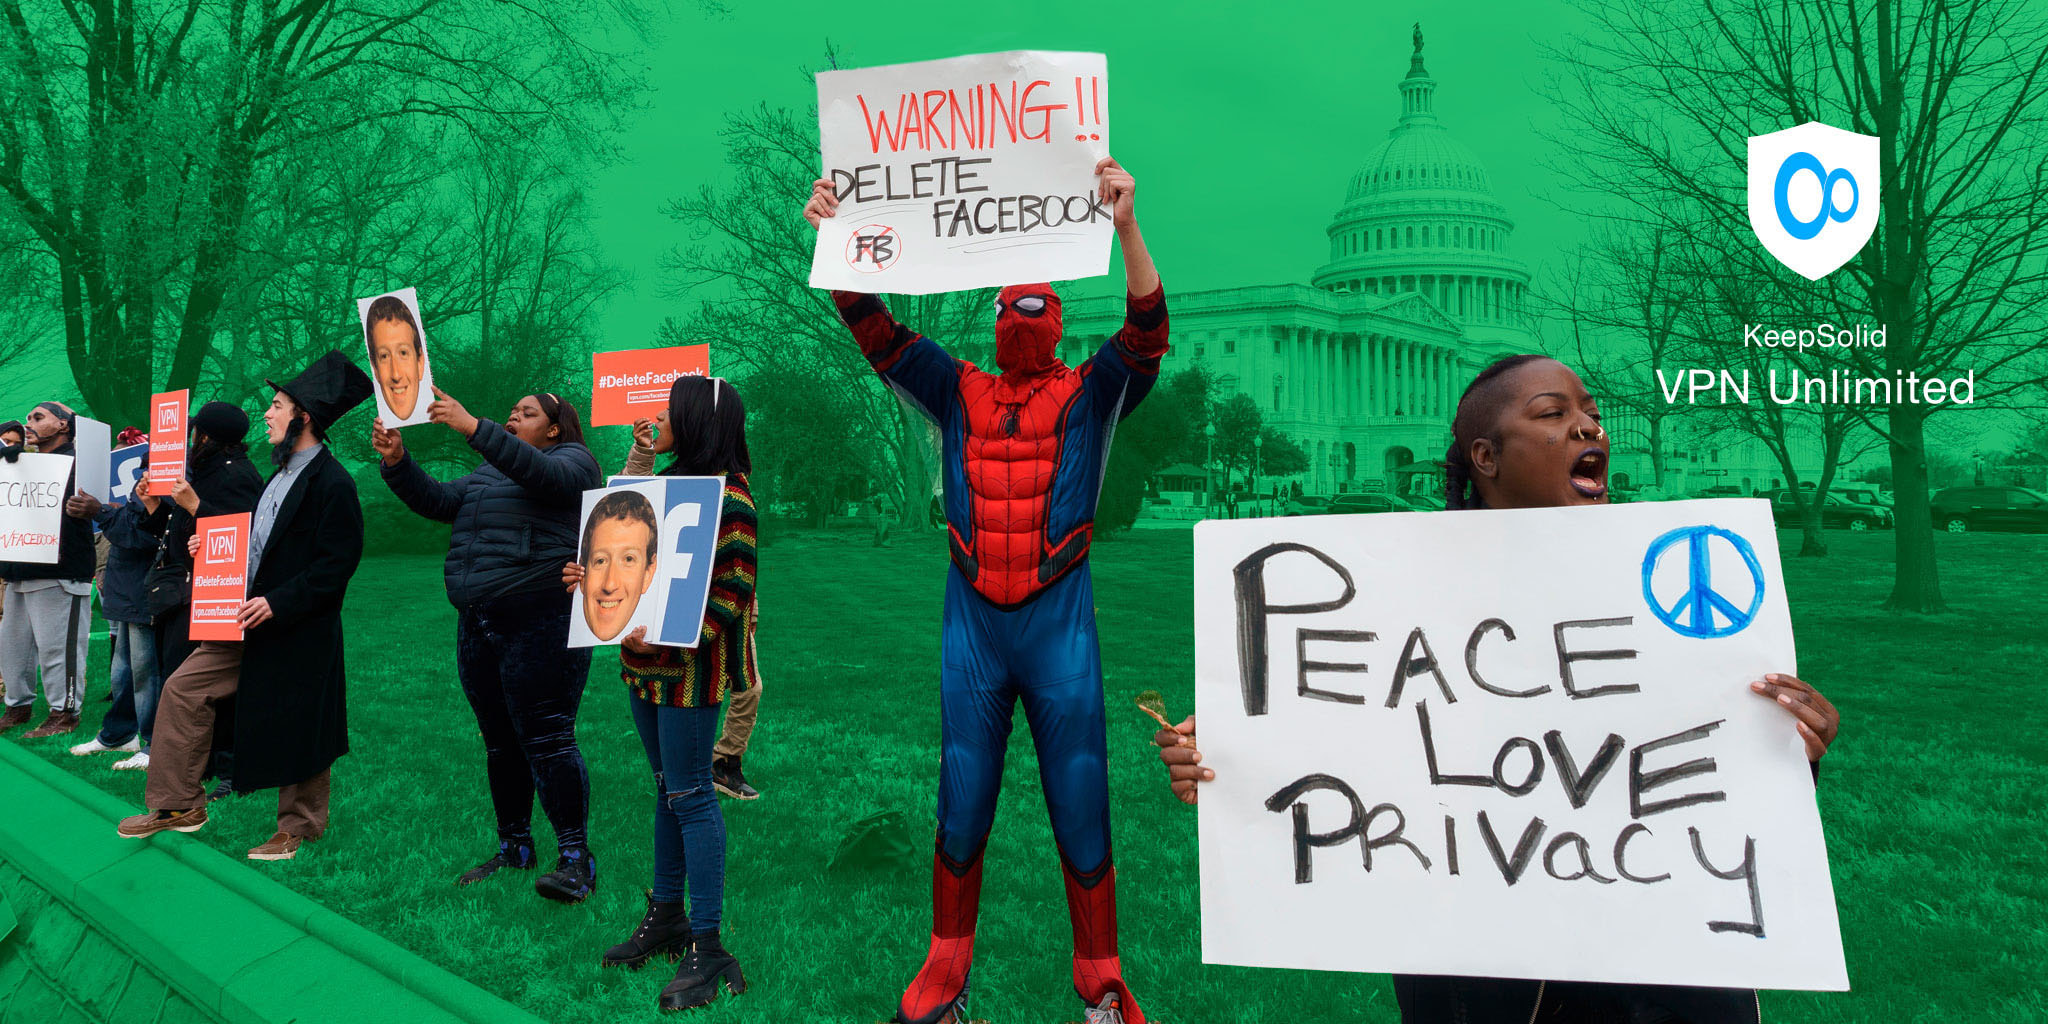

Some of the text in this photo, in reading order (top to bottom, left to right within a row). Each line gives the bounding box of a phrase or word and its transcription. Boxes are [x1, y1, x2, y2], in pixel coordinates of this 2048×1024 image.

[857, 80, 1068, 153] WARNING
[831, 157, 992, 203] DELETE
[933, 190, 1112, 237] FACEBOOK
[855, 235, 893, 264] FB
[161, 408, 177, 426] VPN
[210, 535, 234, 556] VPN
[195, 573, 243, 587] #DeleteFacebook
[1233, 542, 1641, 716] PEACE
[1416, 700, 1726, 819] LOVE
